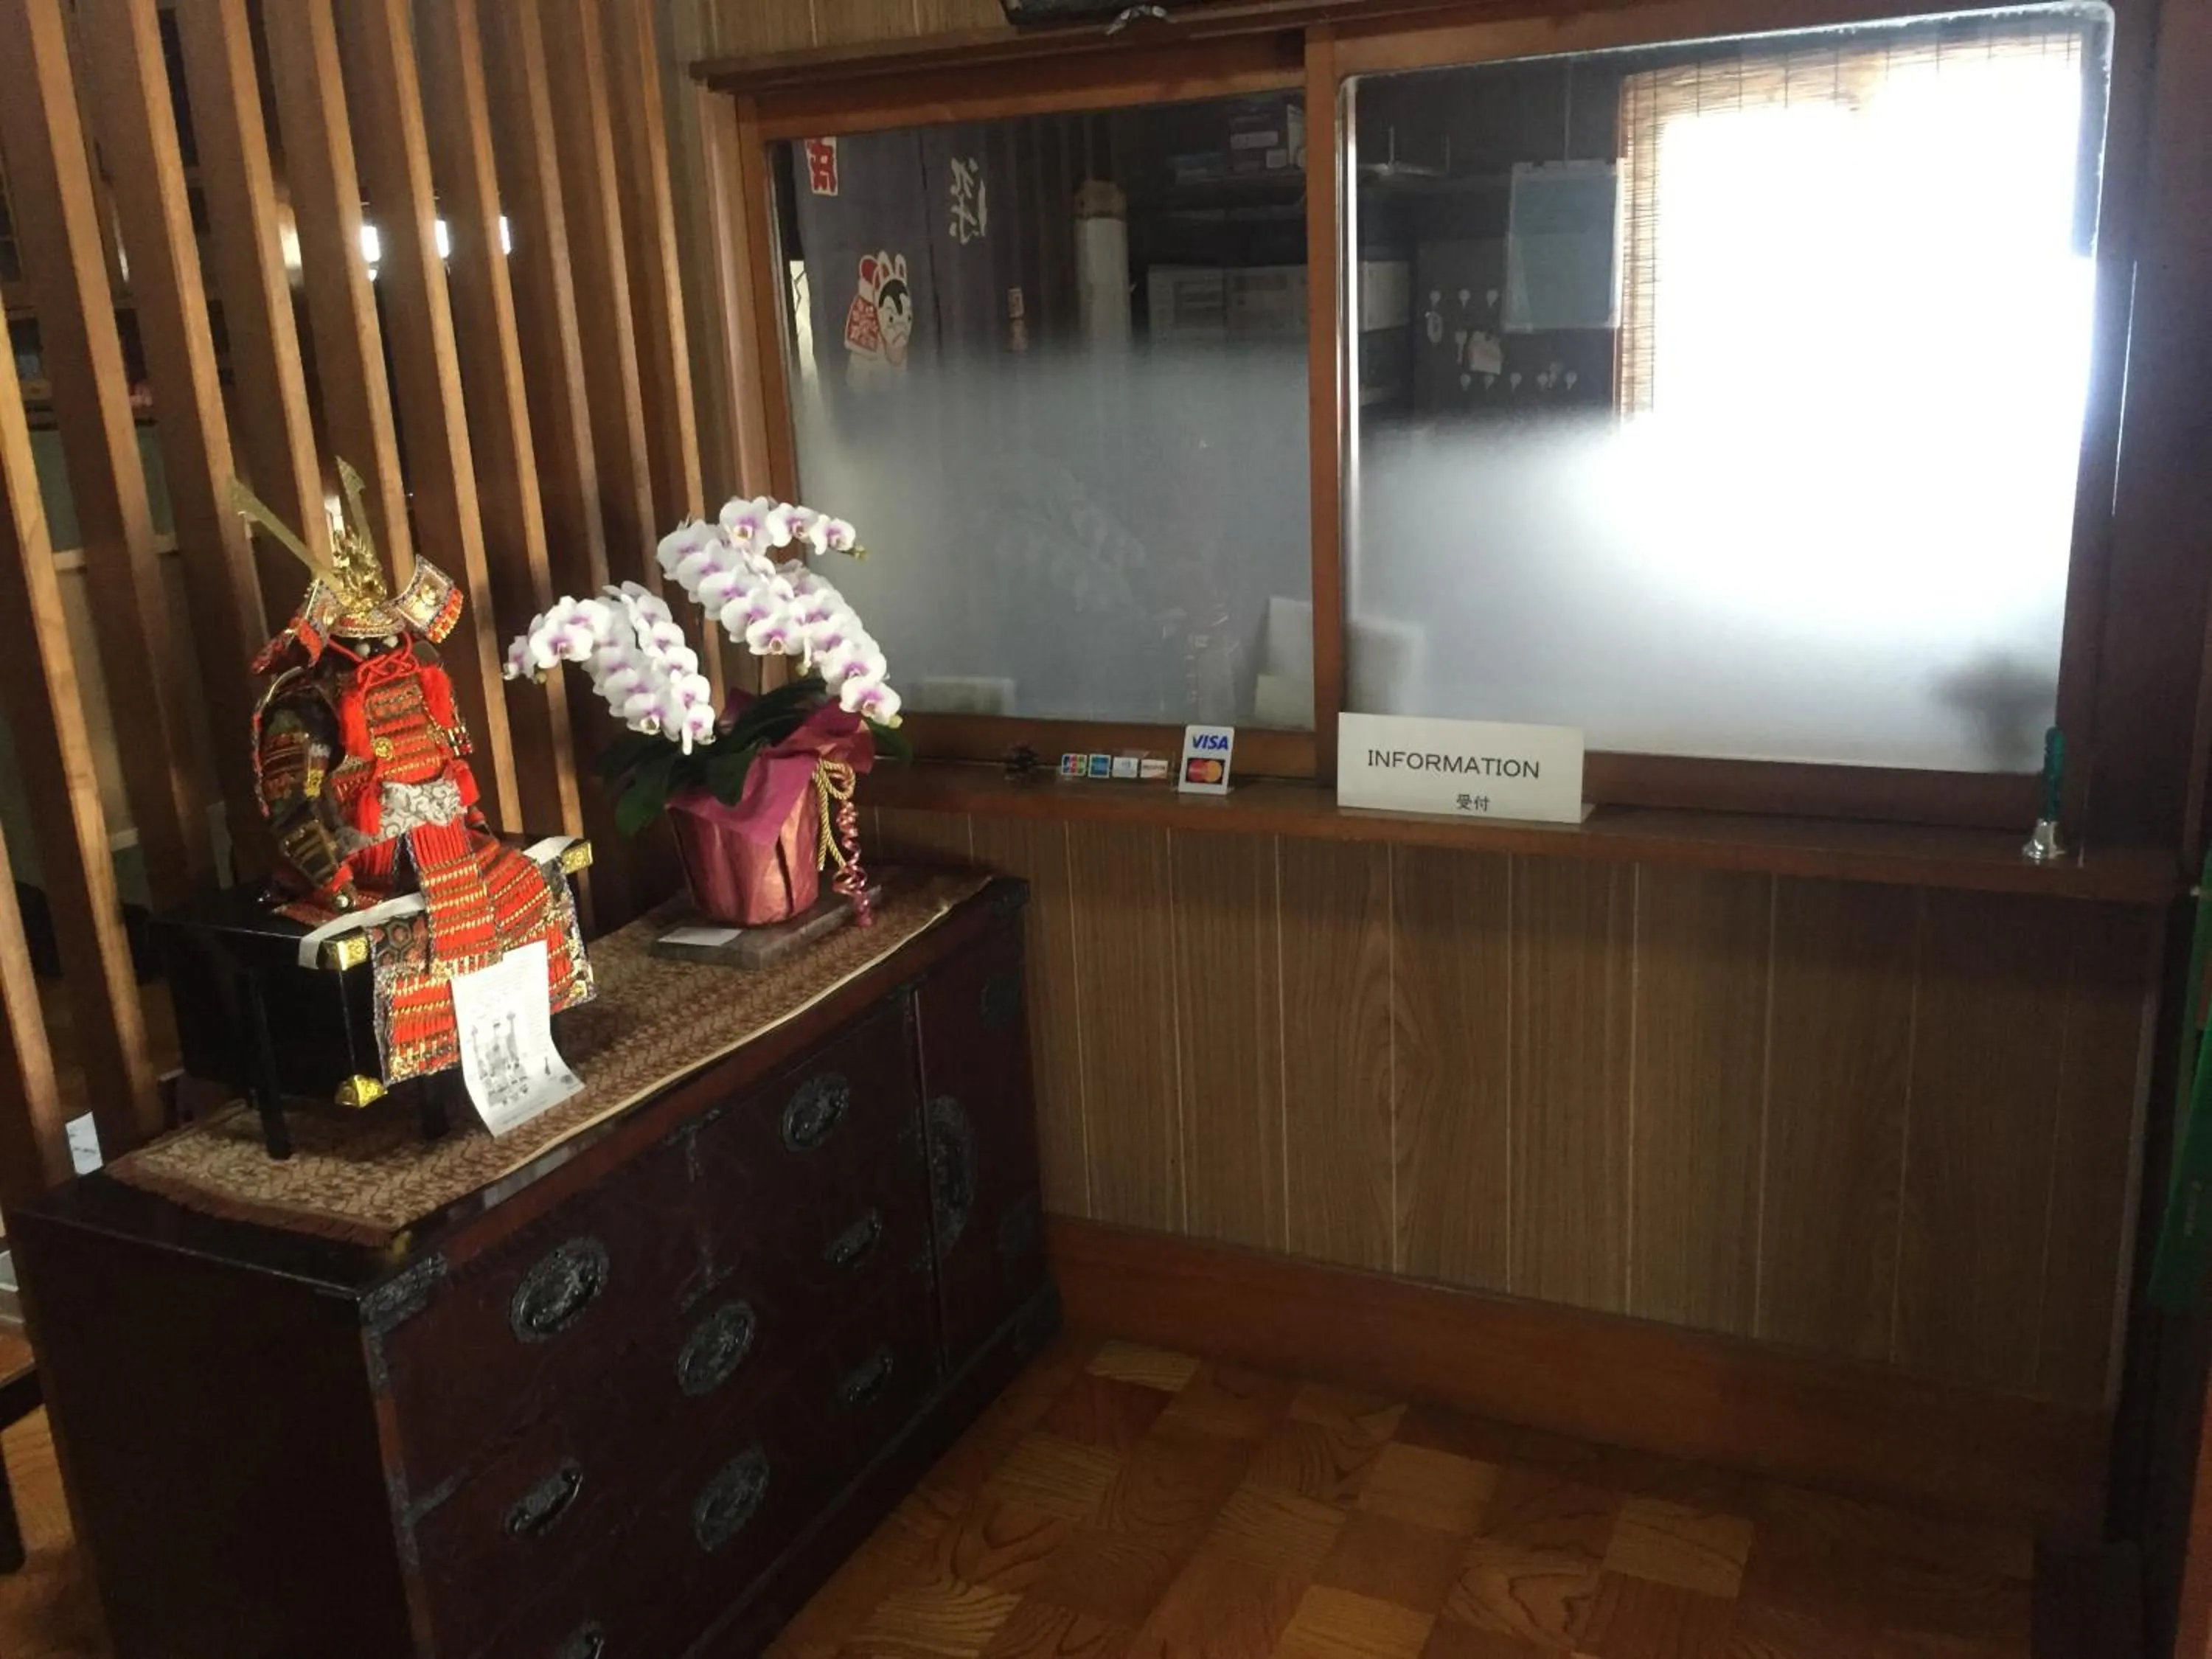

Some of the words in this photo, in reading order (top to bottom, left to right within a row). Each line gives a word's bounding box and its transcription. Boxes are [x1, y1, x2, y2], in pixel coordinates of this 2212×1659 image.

[1192, 734, 1228, 750] VISA
[1368, 749, 1540, 779] INFORMATION
[1456, 793, 1490, 812] 受付
